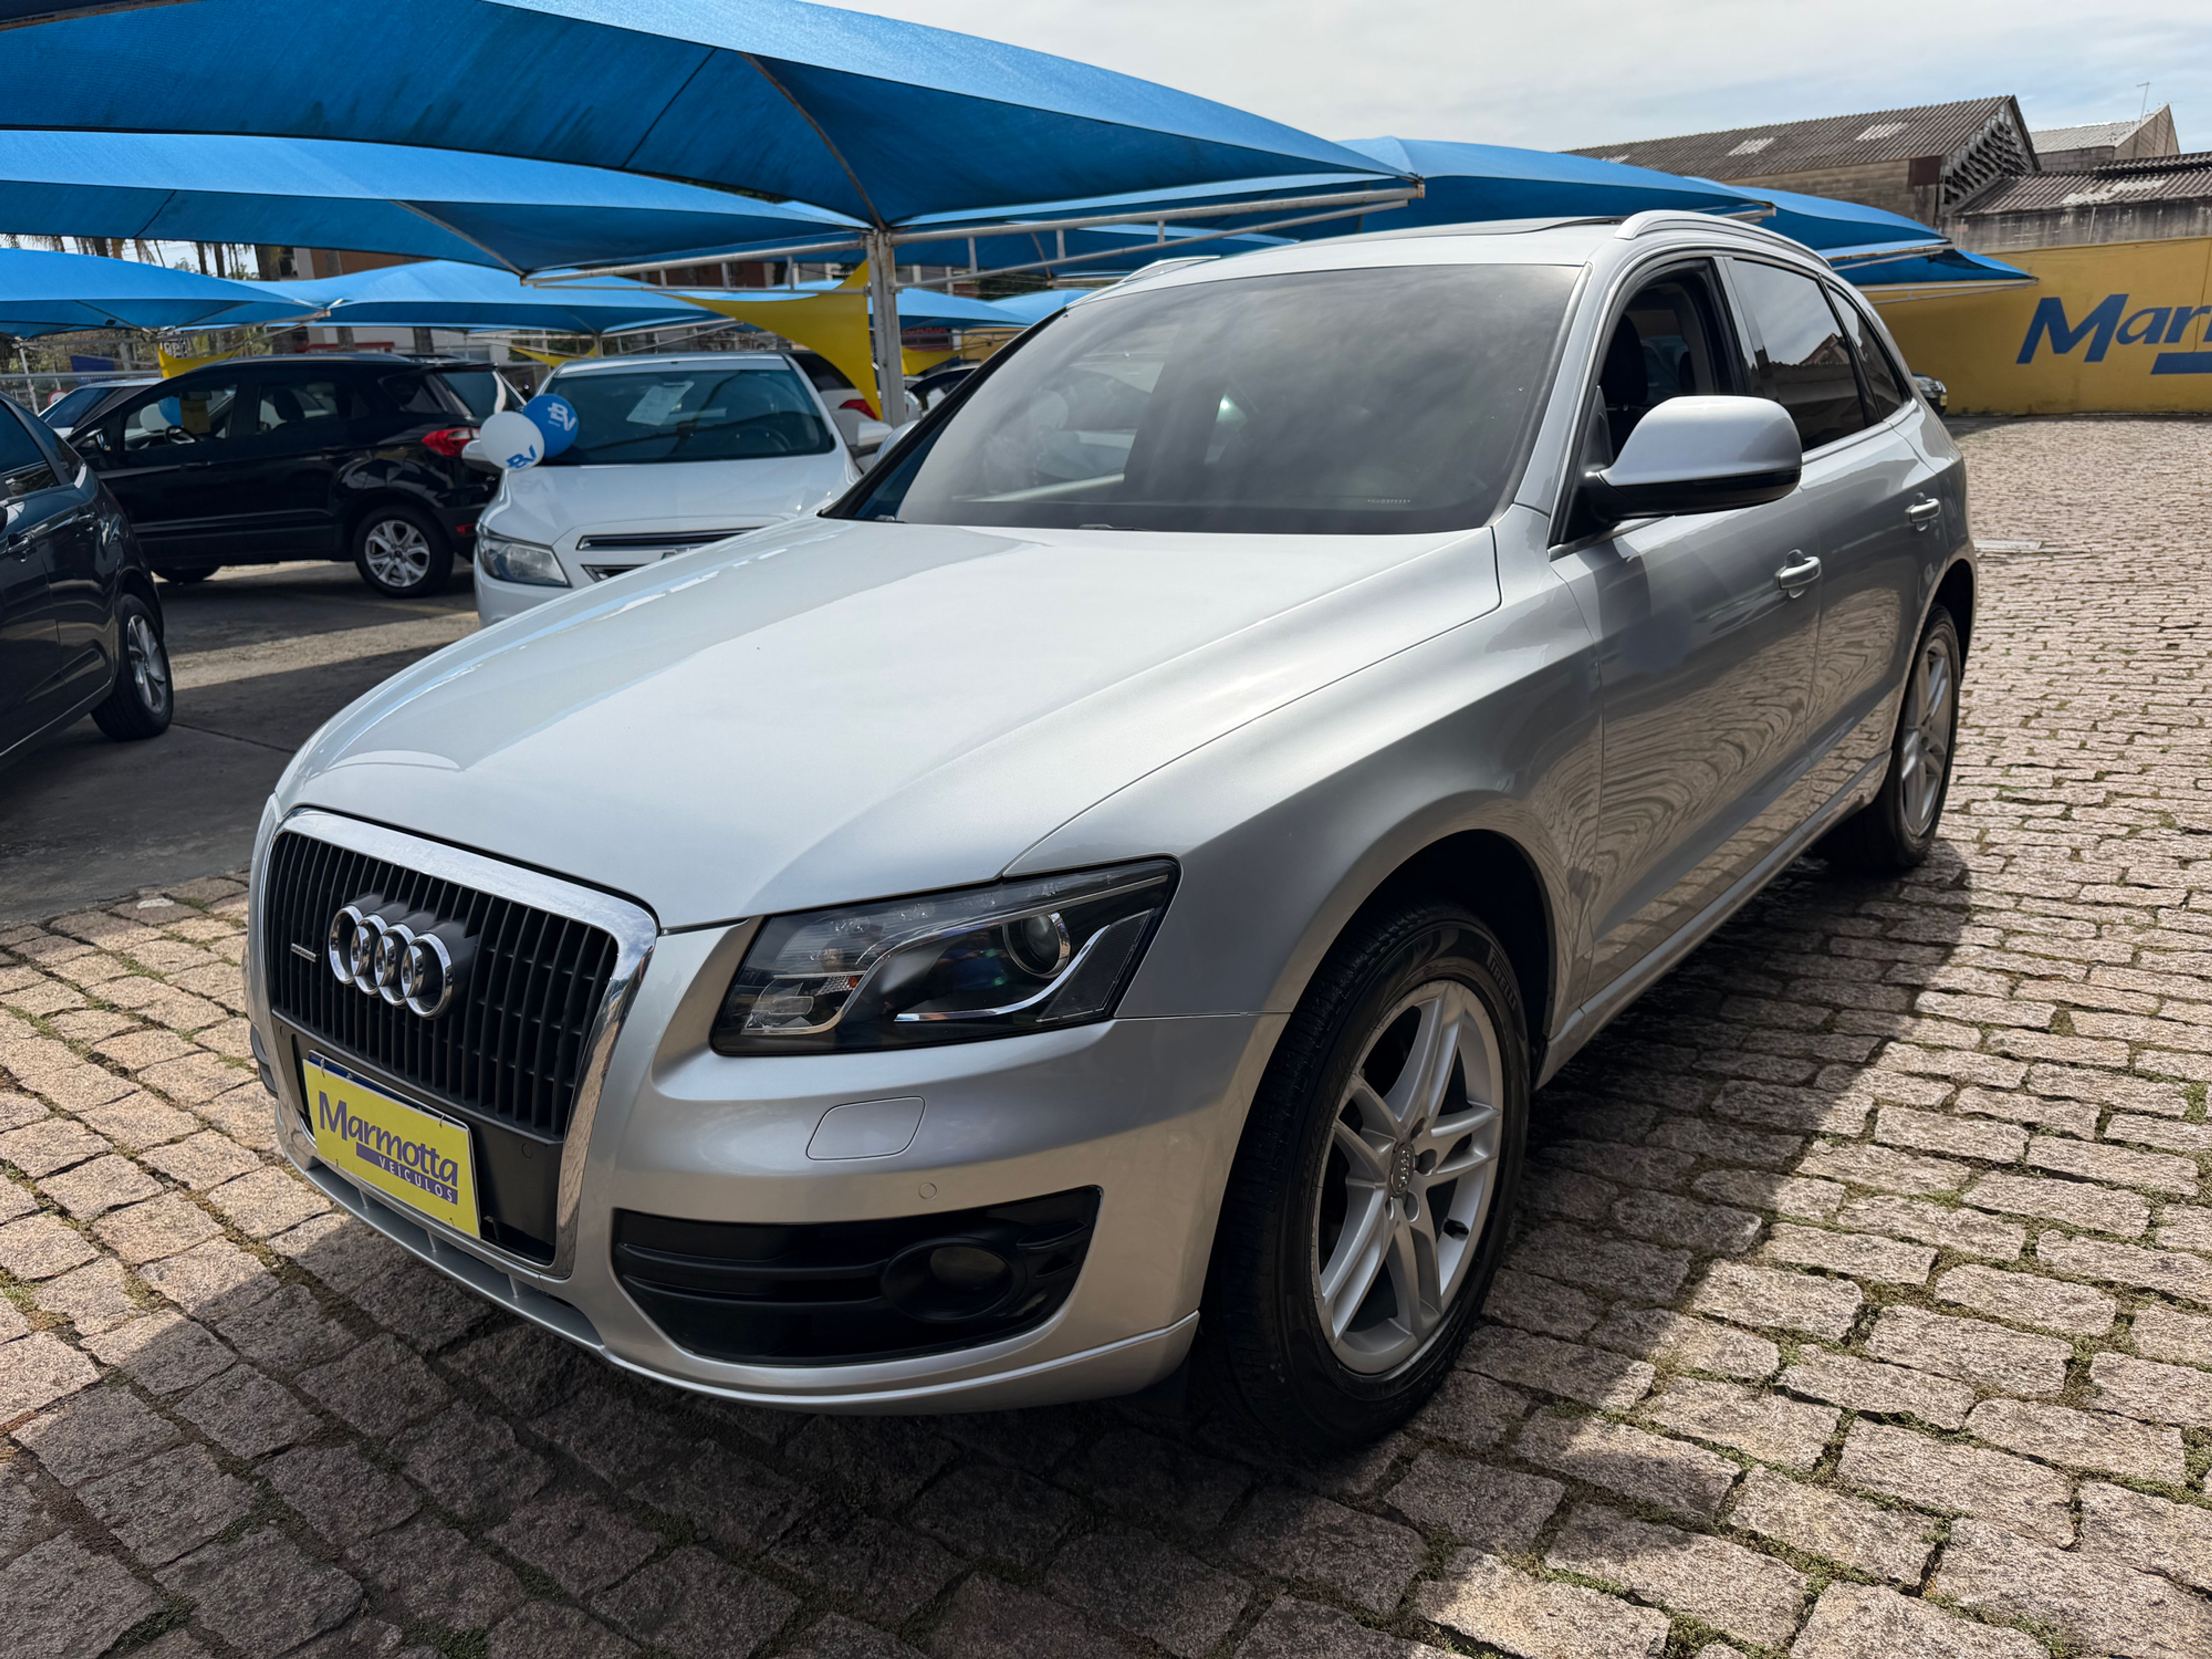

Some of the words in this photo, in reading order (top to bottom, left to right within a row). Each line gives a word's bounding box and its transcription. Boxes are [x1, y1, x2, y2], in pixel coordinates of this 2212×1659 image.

[2016, 294, 2212, 364] Mar
[1486, 945, 1517, 1011] PIRELLI
[319, 1090, 458, 1188] Marmotta
